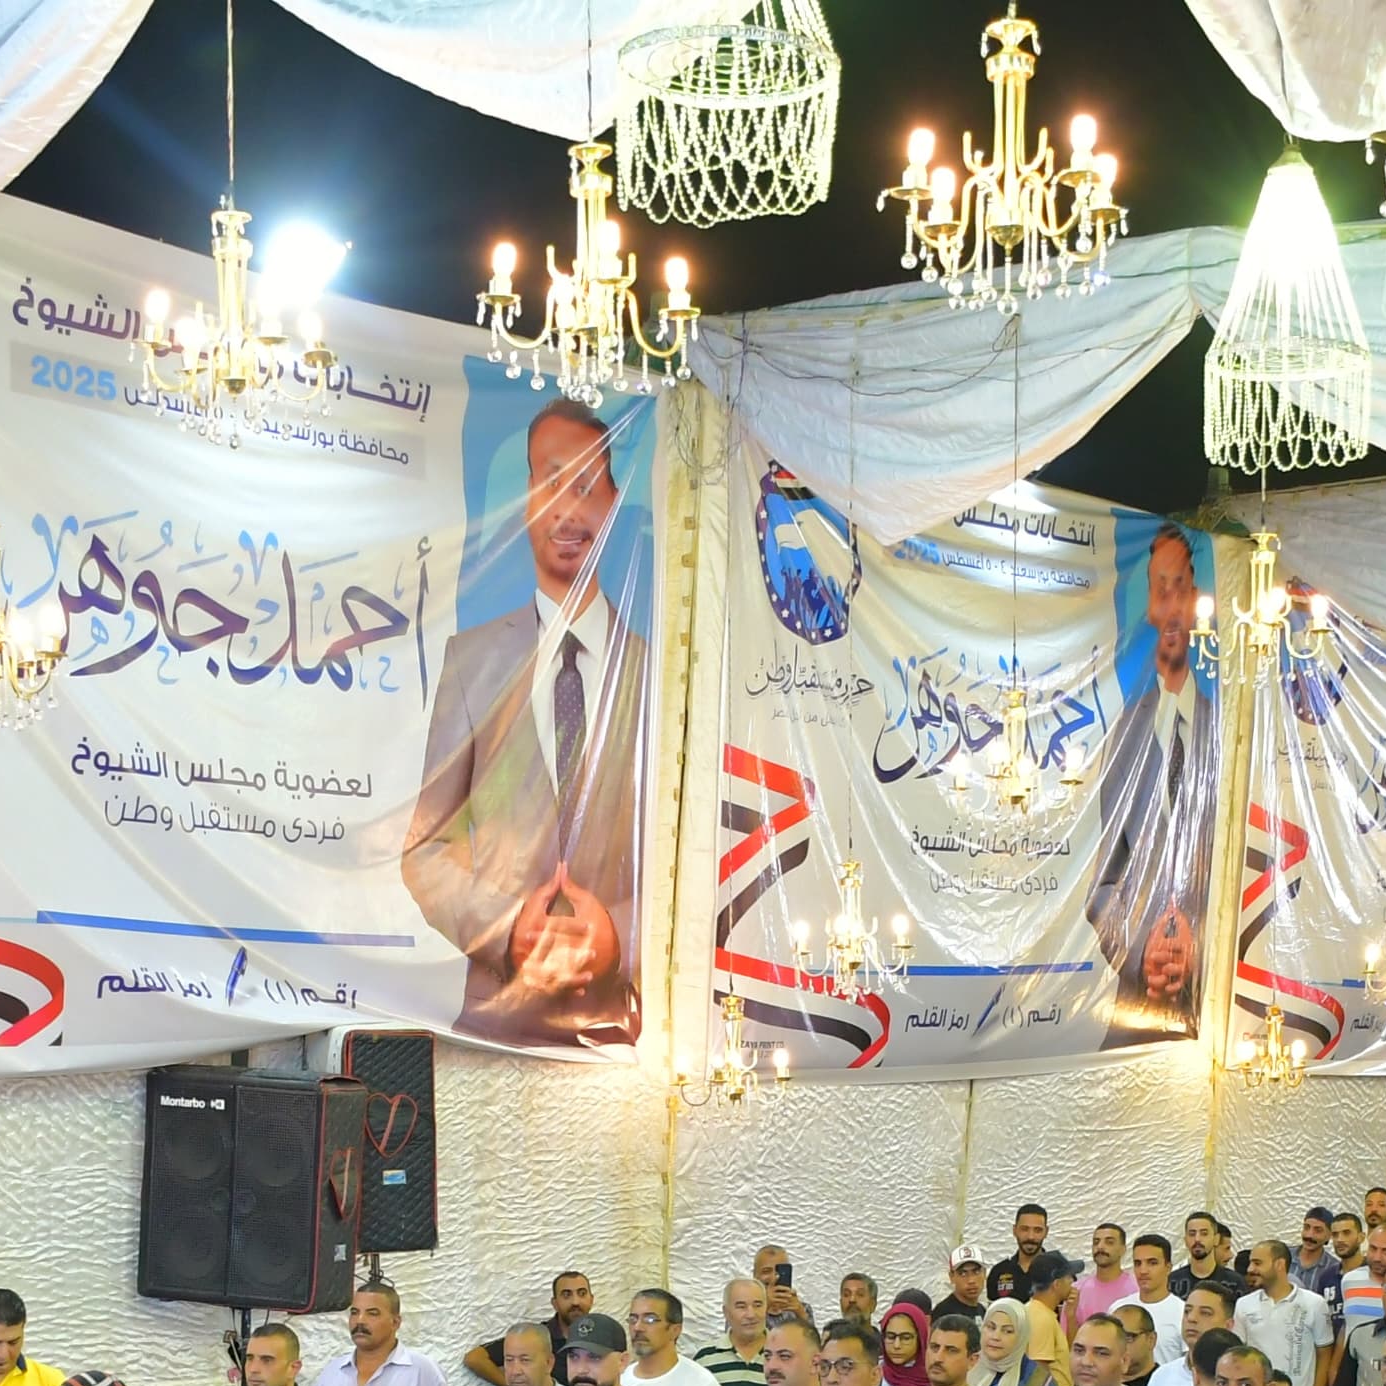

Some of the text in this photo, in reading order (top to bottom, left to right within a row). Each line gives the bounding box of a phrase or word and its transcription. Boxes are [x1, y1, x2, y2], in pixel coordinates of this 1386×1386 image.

[12, 277, 141, 340] الشيوخ
[31, 354, 117, 401] 2025
[339, 428, 410, 465] محافظة
[1024, 513, 1097, 555] إنتخابات
[1051, 567, 1091, 590] محافظة
[228, 535, 432, 712] أحمد
[71, 737, 373, 800] لعضوية مجلس الشيوخ
[104, 795, 174, 832] وطن
[179, 801, 276, 838] مستقبل
[968, 833, 1018, 858] مجلس
[97, 967, 174, 999] القلم
[176, 972, 213, 1000] رمز
[301, 982, 358, 1009] رقم
[904, 1005, 948, 1032] القلم
[948, 1008, 970, 1031] رمز
[1027, 1003, 1062, 1028] رقم
[160, 1095, 206, 1110] Montarbo
